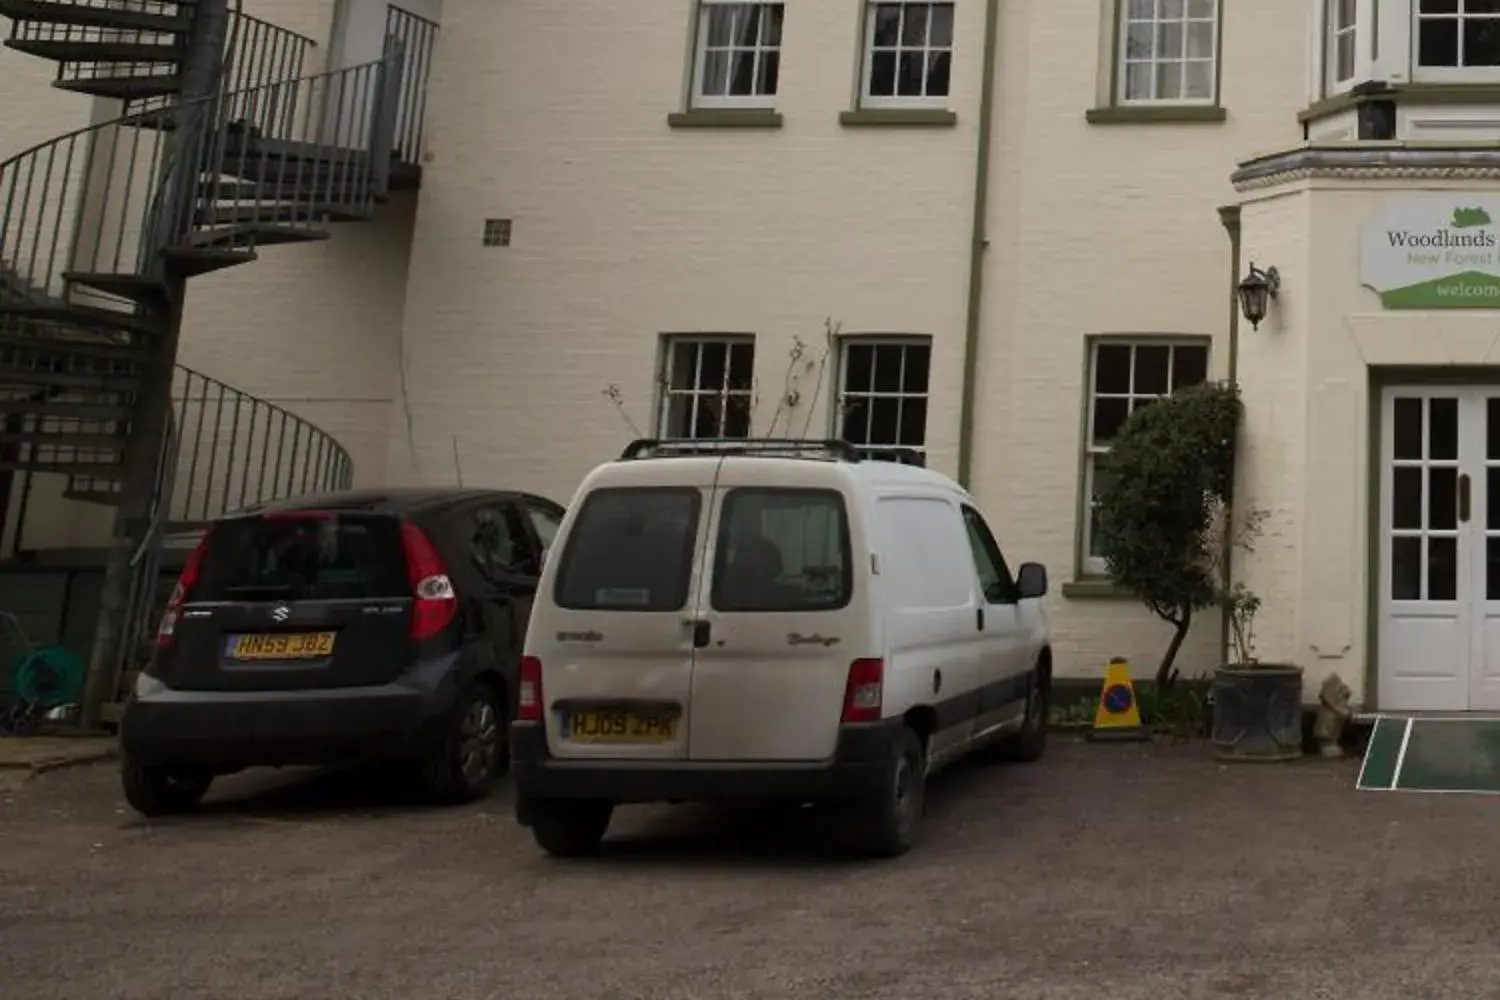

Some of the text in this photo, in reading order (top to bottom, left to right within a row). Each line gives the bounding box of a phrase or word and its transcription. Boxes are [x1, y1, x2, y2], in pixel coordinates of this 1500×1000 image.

[1387, 230, 1495, 248] Woodlands
[1407, 252, 1439, 265] New
[1445, 252, 1492, 265] Forest
